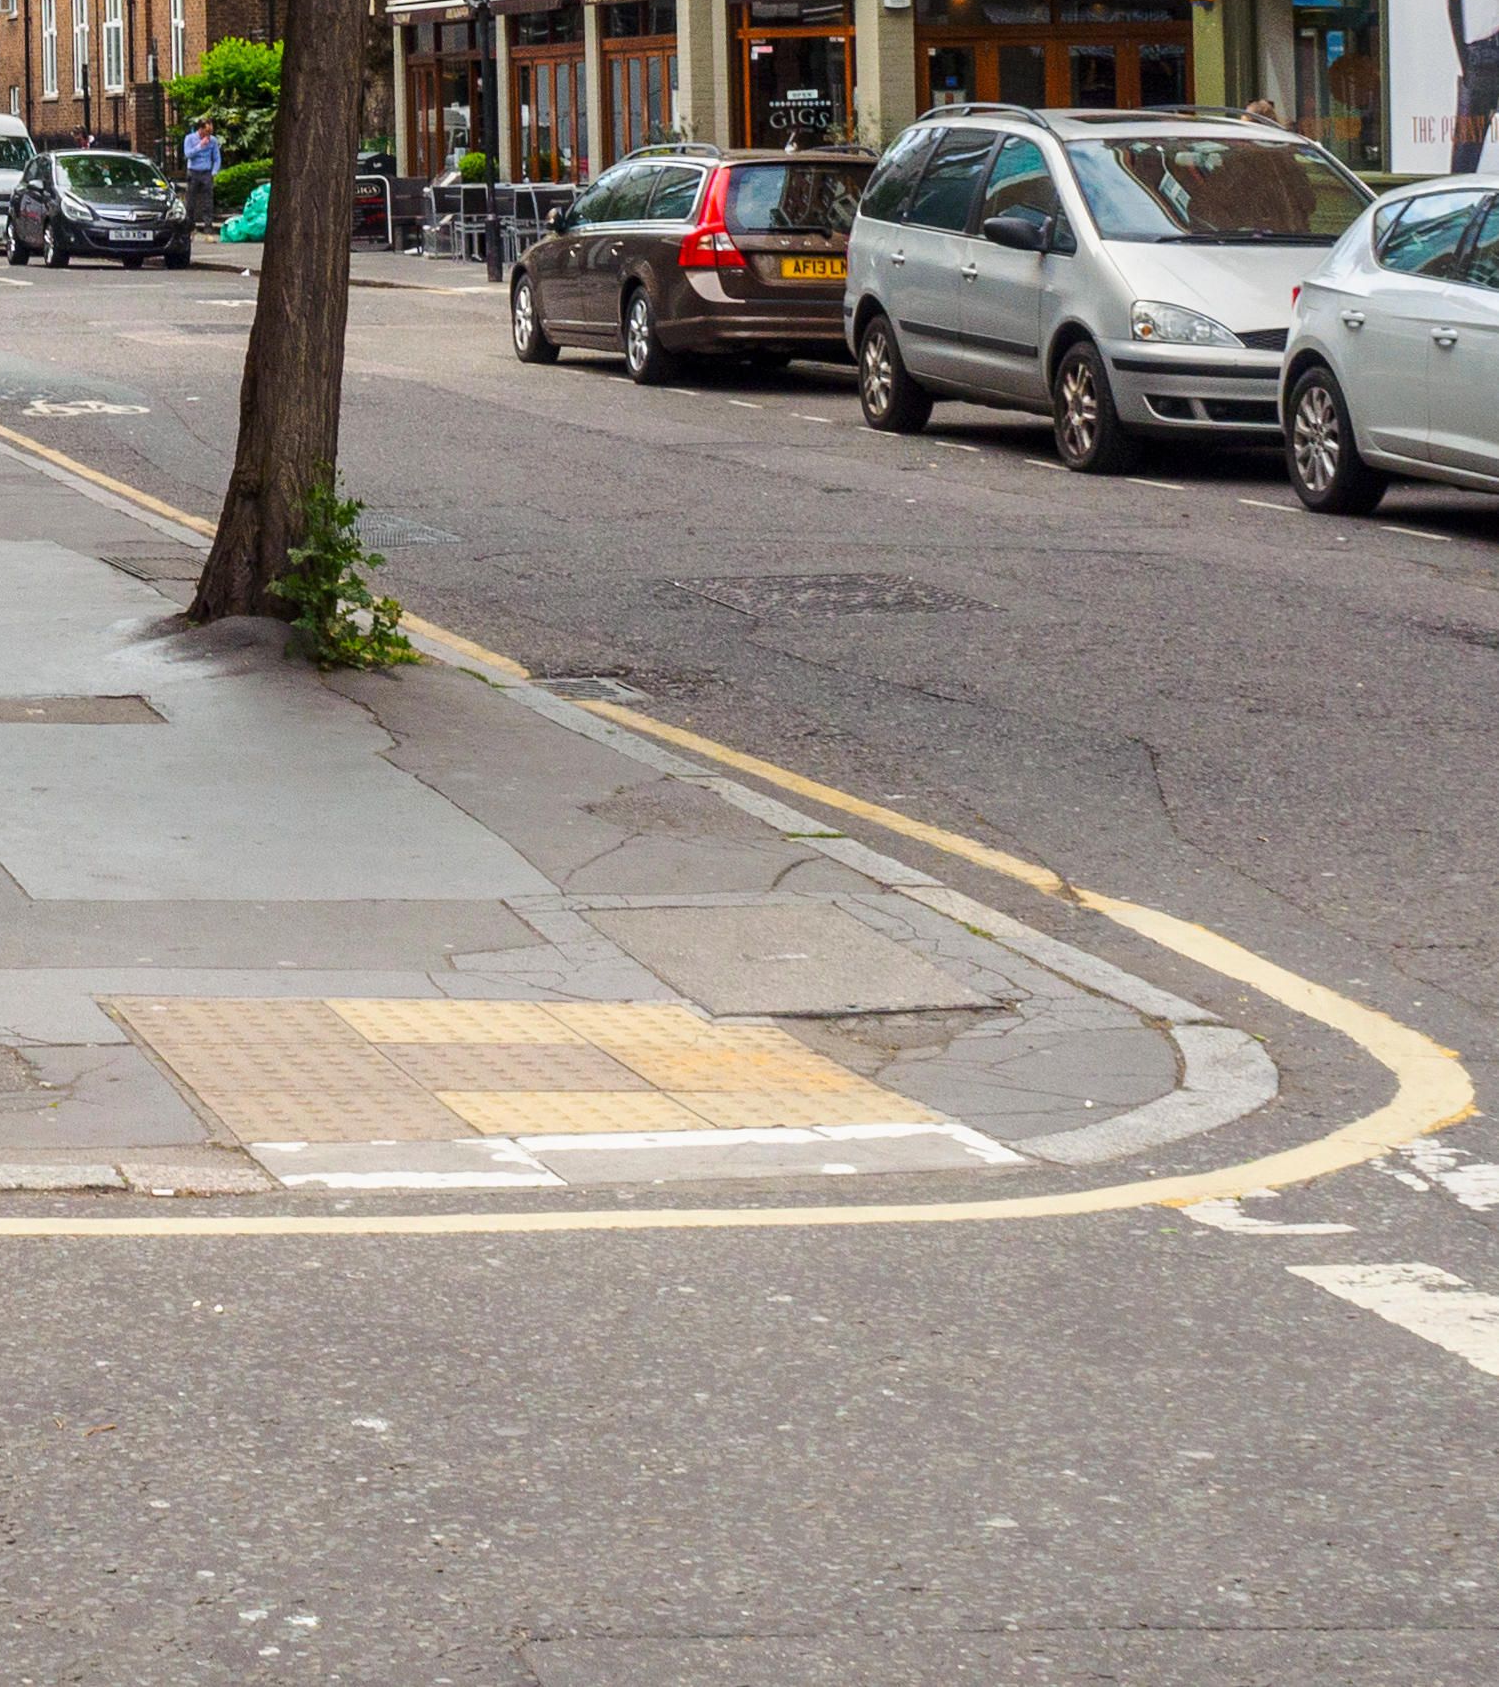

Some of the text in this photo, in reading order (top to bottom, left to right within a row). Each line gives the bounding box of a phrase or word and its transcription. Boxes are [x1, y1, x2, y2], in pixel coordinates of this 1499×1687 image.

[769, 108, 829, 129] GIGS
[1412, 116, 1435, 144] THE
[793, 259, 826, 274] AF13
